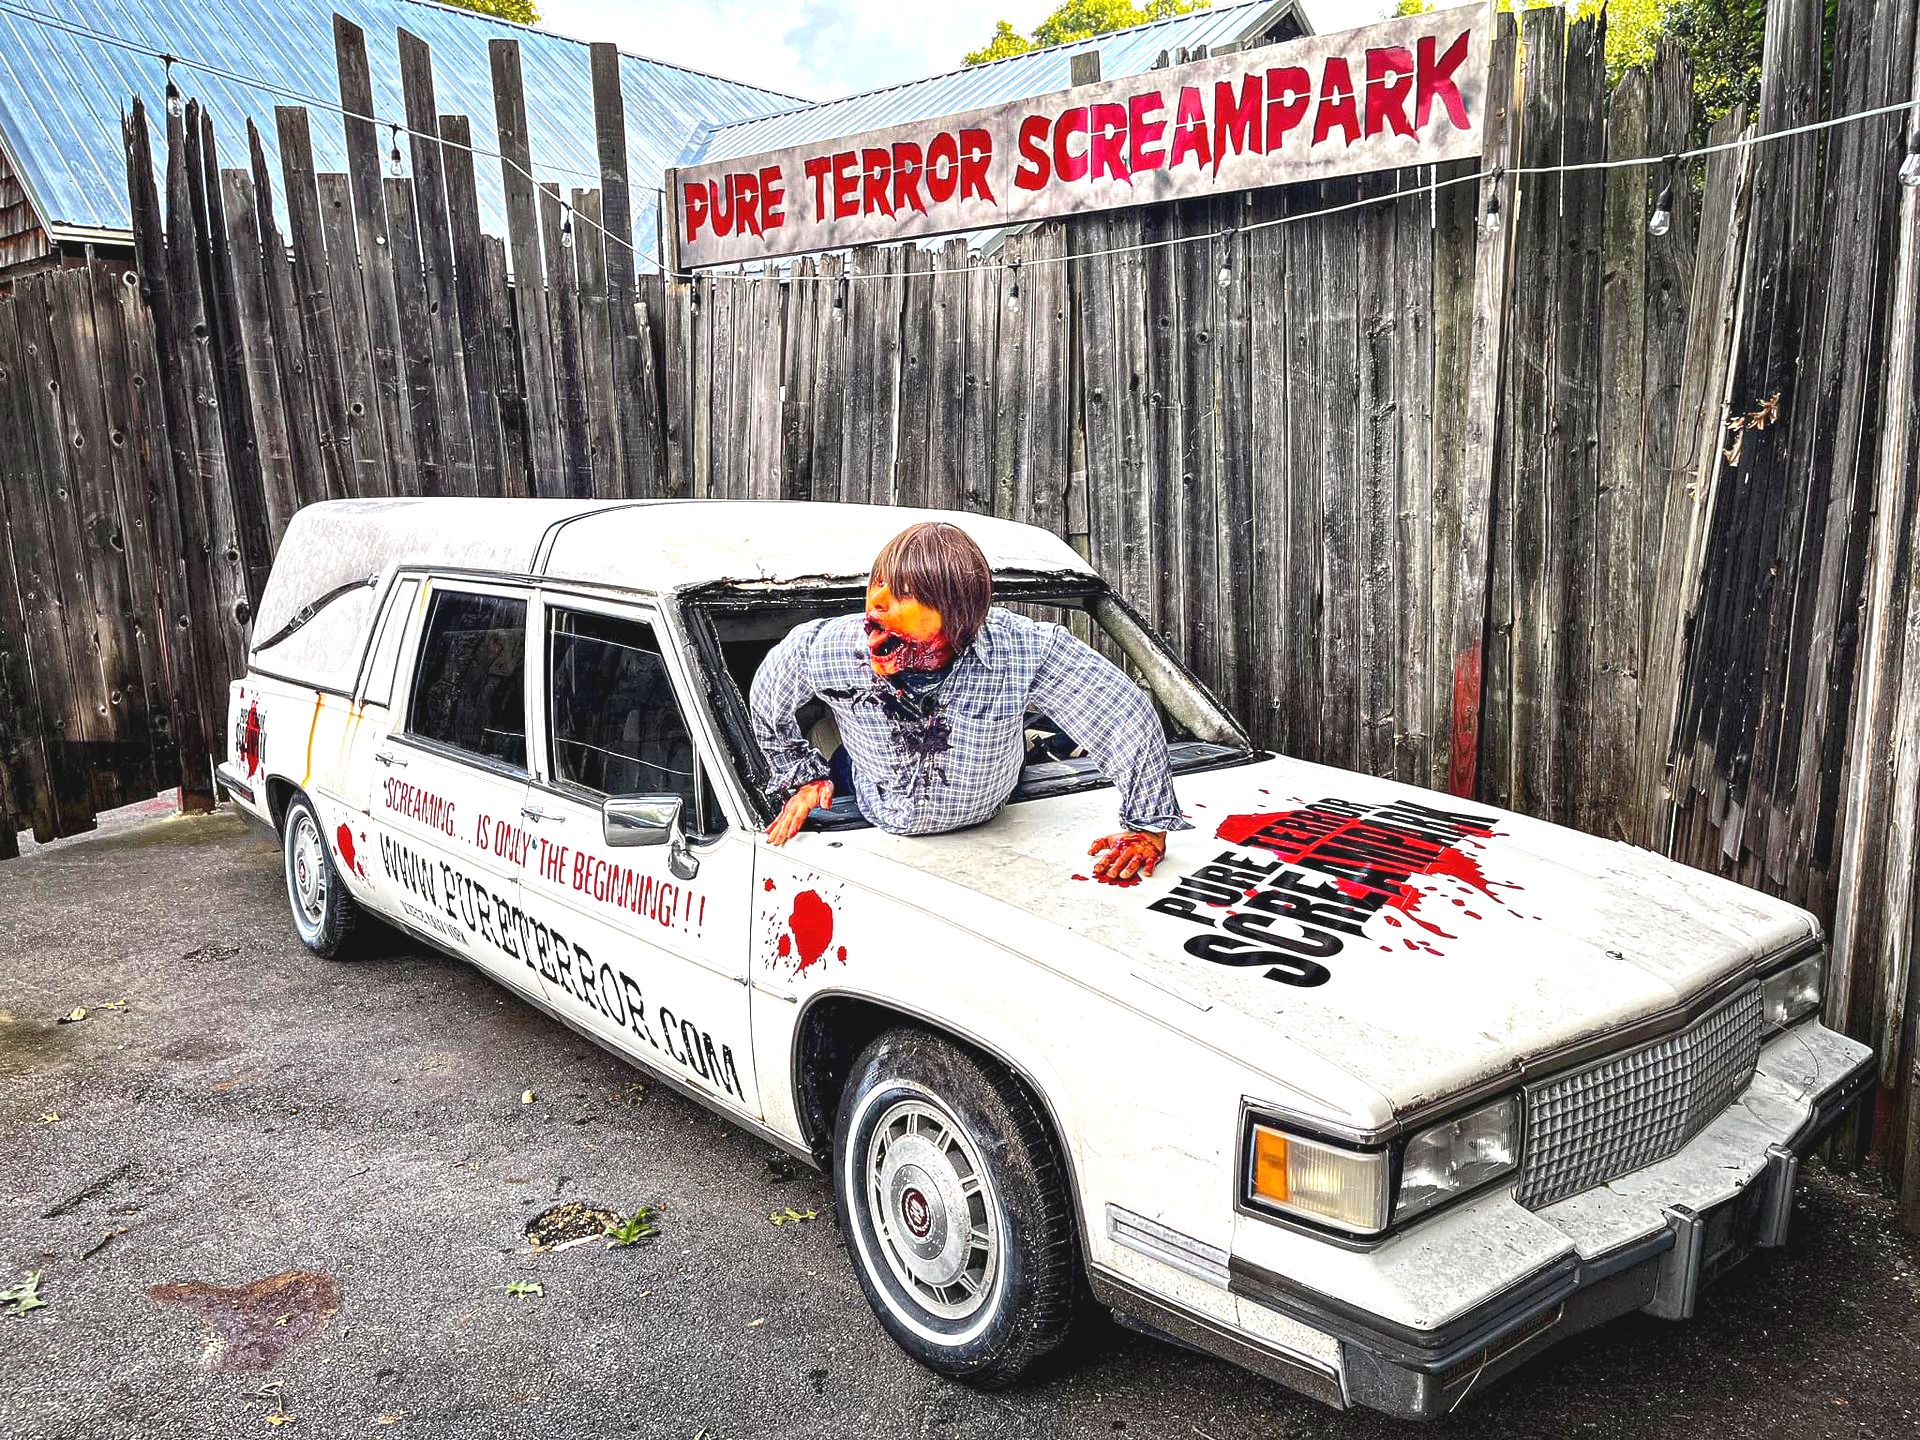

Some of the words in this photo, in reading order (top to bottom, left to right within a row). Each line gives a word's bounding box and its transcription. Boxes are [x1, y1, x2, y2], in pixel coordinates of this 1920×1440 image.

[683, 165, 786, 244] PURE
[804, 129, 997, 224] TERROR
[1014, 28, 1472, 191] SCREAMPARK
[476, 813, 491, 850] IS
[494, 820, 532, 868] ONLY
[540, 837, 570, 884] THE
[1146, 850, 1283, 929] PURE
[1236, 797, 1378, 855] TERROR
[1183, 800, 1500, 988] SCREAMPARK
